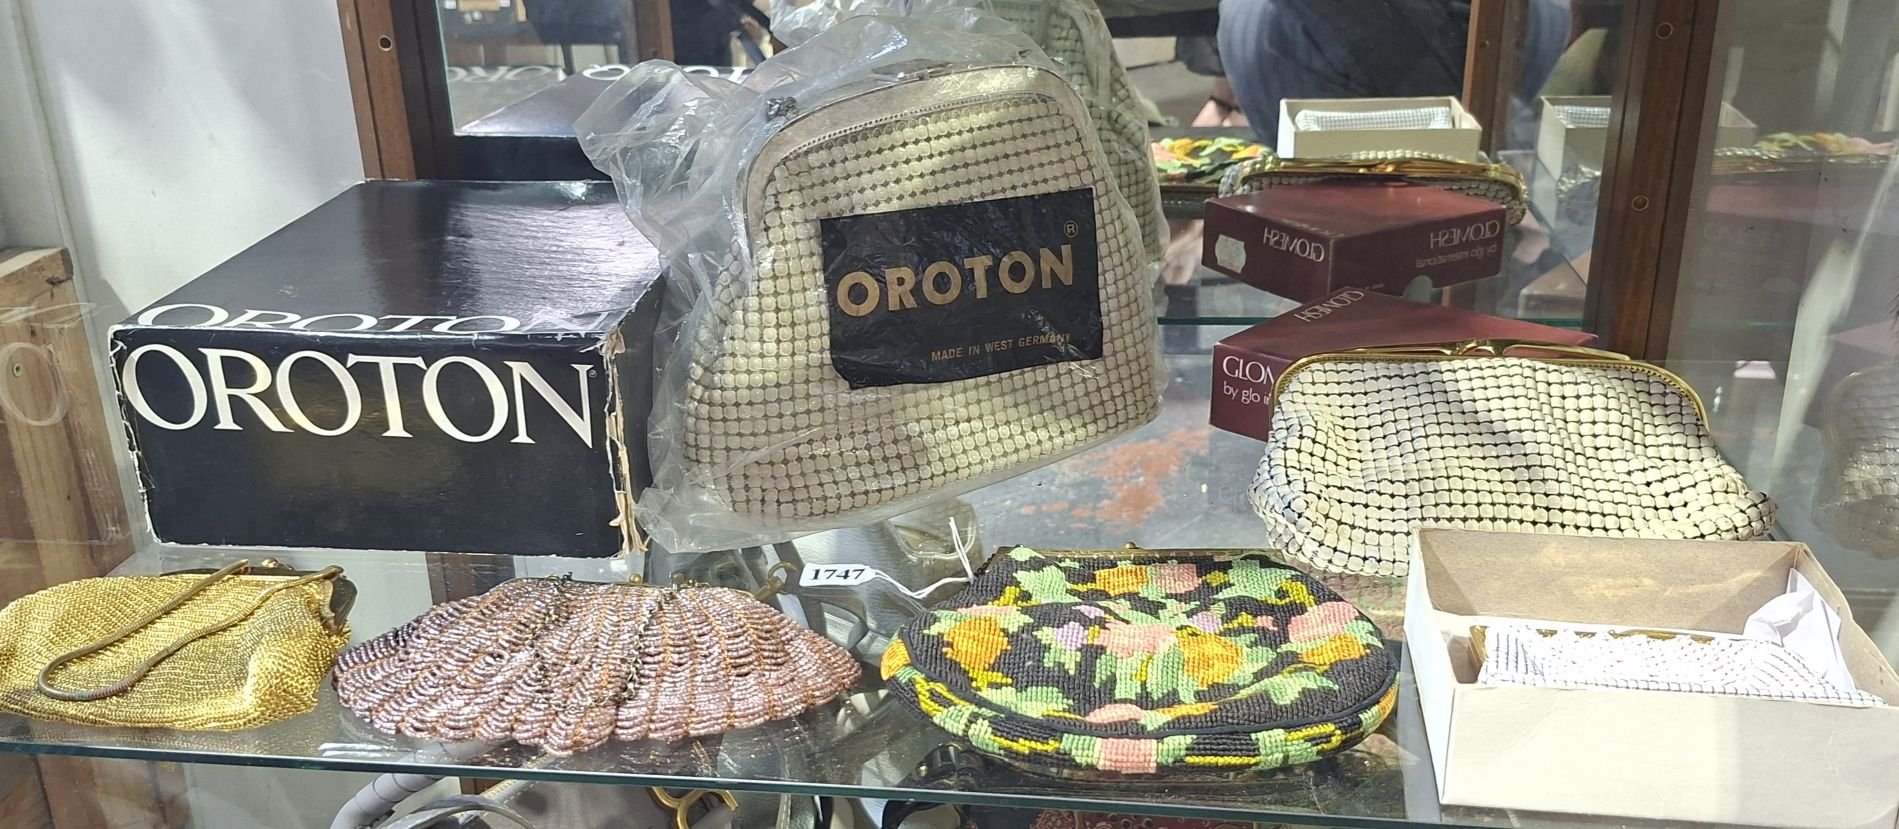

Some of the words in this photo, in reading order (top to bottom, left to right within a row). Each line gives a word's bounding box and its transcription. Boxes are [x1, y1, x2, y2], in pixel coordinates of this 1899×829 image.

[836, 244, 1073, 317] OROTON
[137, 303, 609, 334] OROTON
[1293, 290, 1365, 323] GLOMESH
[931, 347, 963, 362] MADE
[968, 345, 980, 356] IN
[985, 339, 1014, 352] WEST
[1018, 332, 1071, 347] GERMANY
[122, 343, 594, 449] OROTON
[1223, 380, 1239, 400] by
[1241, 387, 1261, 405] glo
[810, 568, 866, 580] 1747
